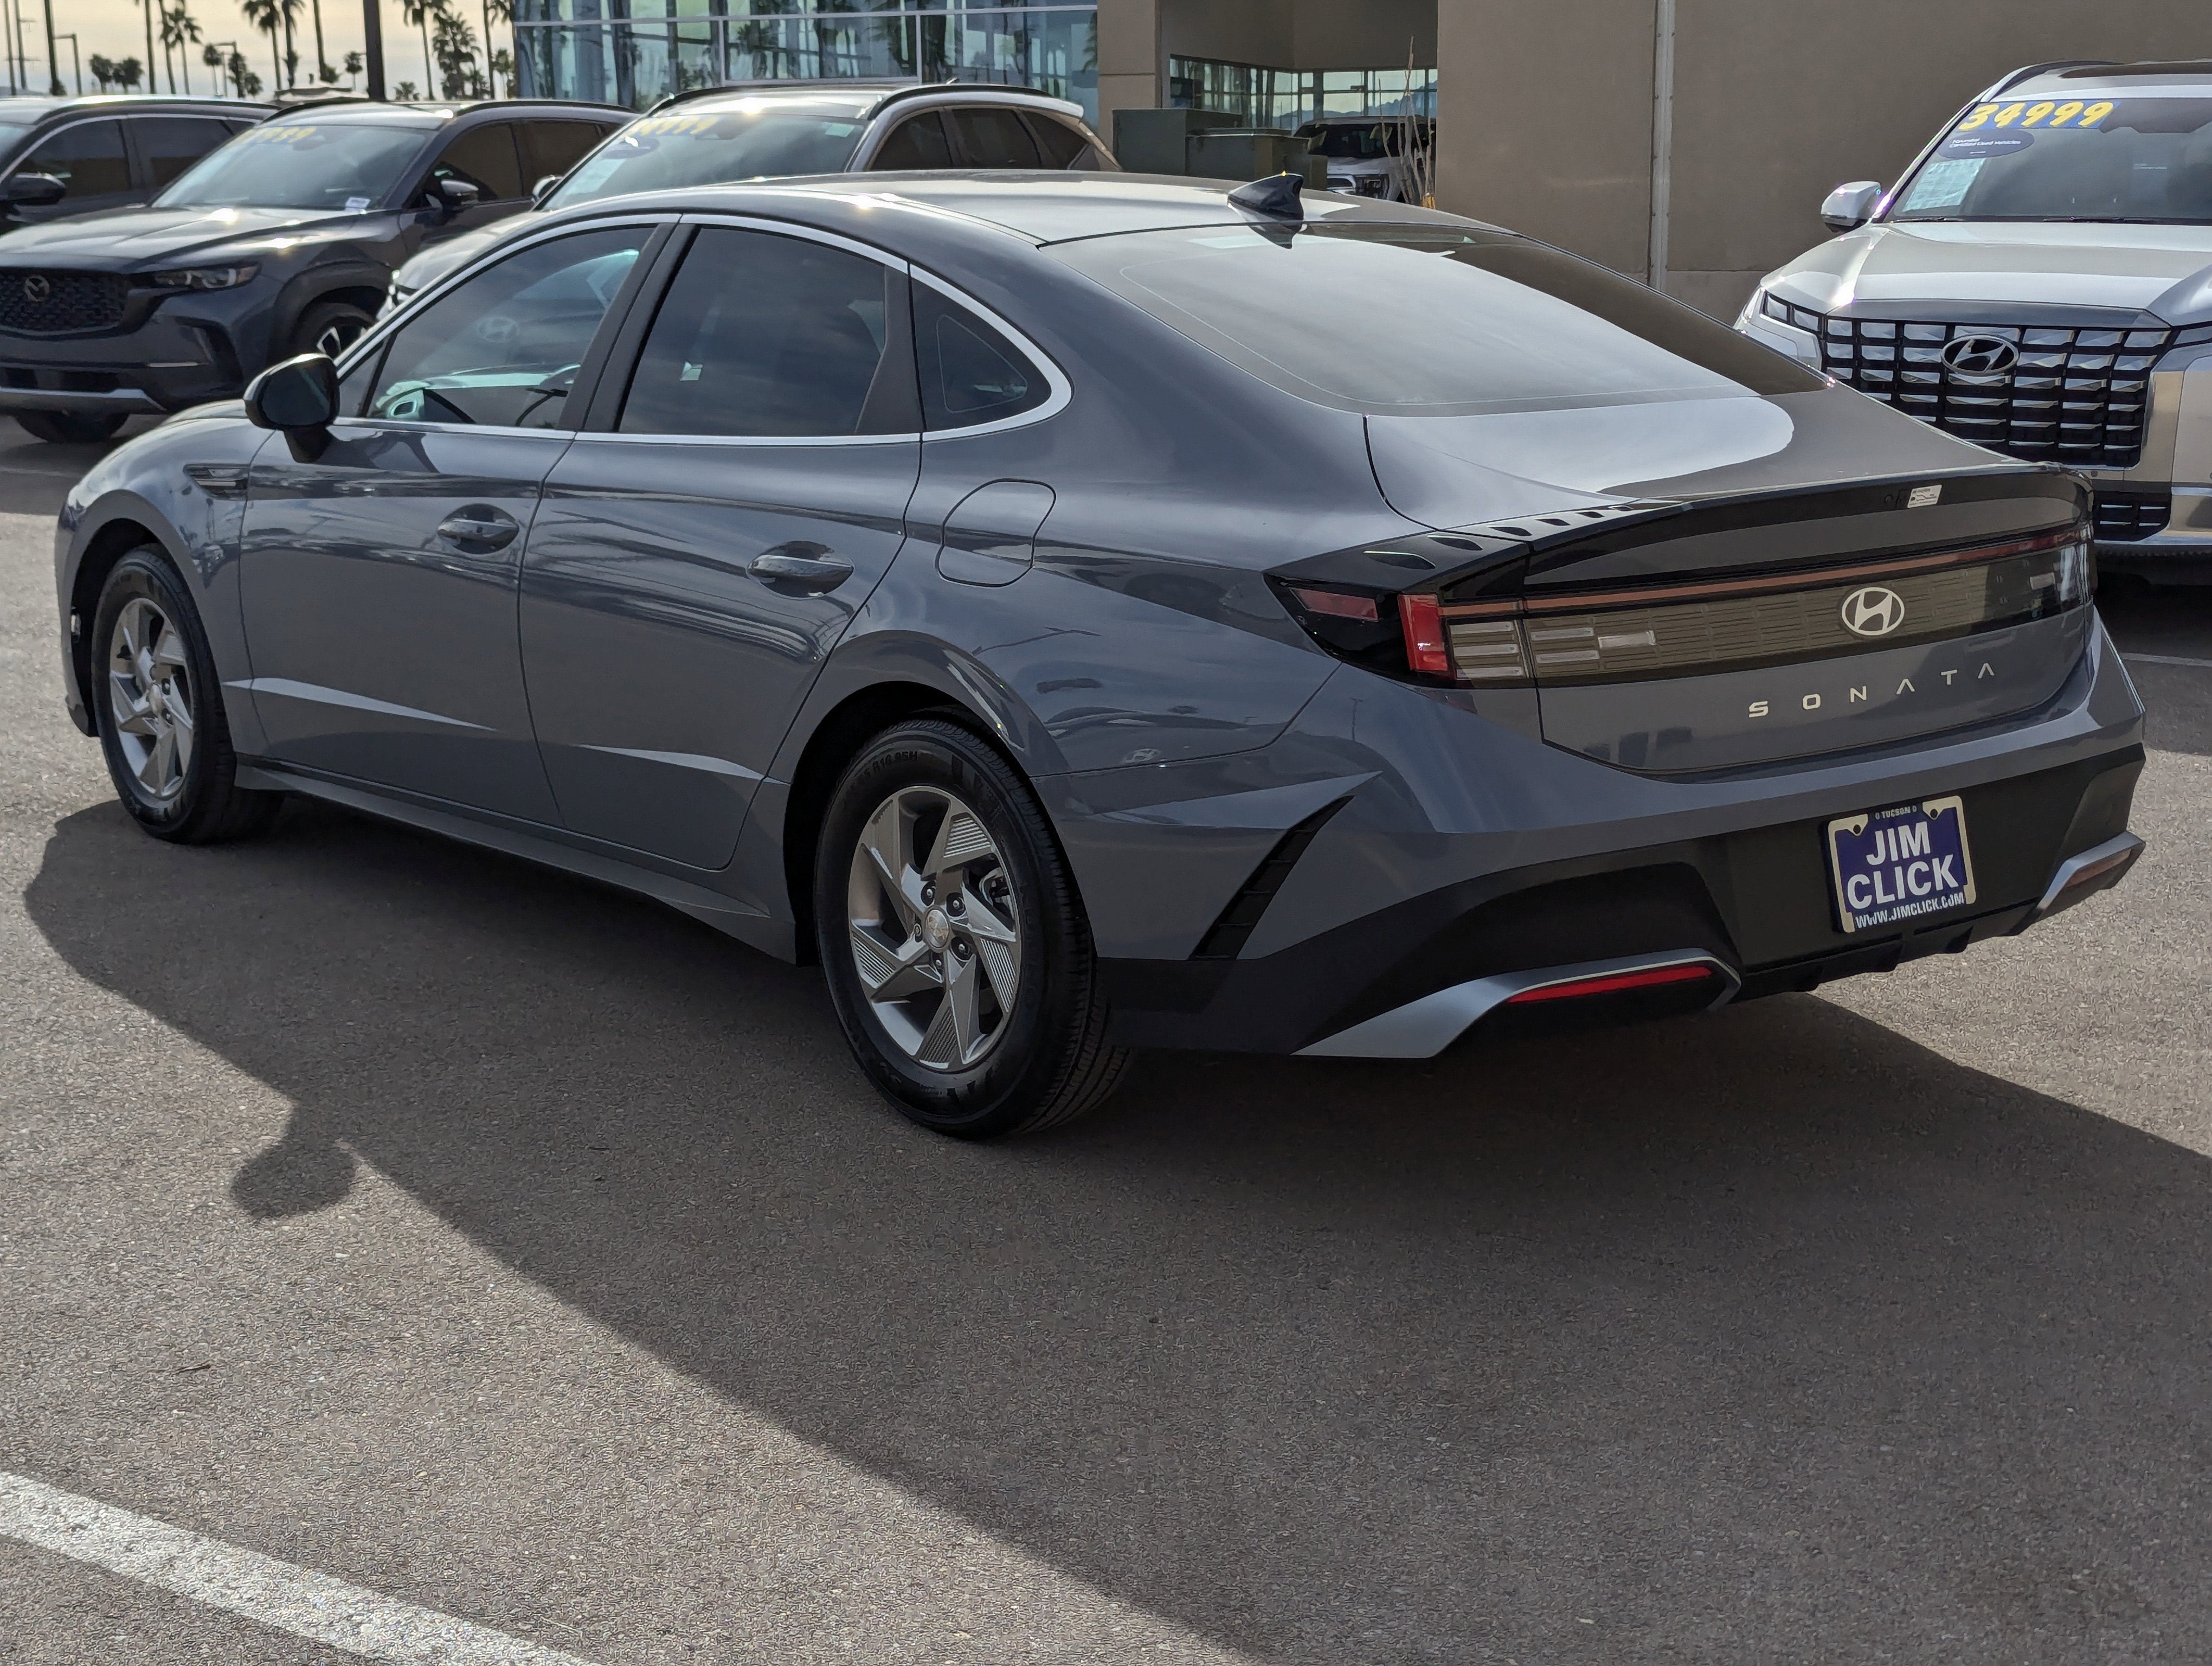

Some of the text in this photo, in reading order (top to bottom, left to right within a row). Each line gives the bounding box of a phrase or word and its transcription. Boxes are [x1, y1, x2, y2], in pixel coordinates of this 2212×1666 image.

[1958, 101, 2114, 132] 34999
[1748, 662, 1995, 718] SONATA
[1866, 821, 1931, 866] JIM
[1847, 854, 1959, 909] CLICK
[1855, 892, 1965, 929] WWW.JIMCLICK.COM
